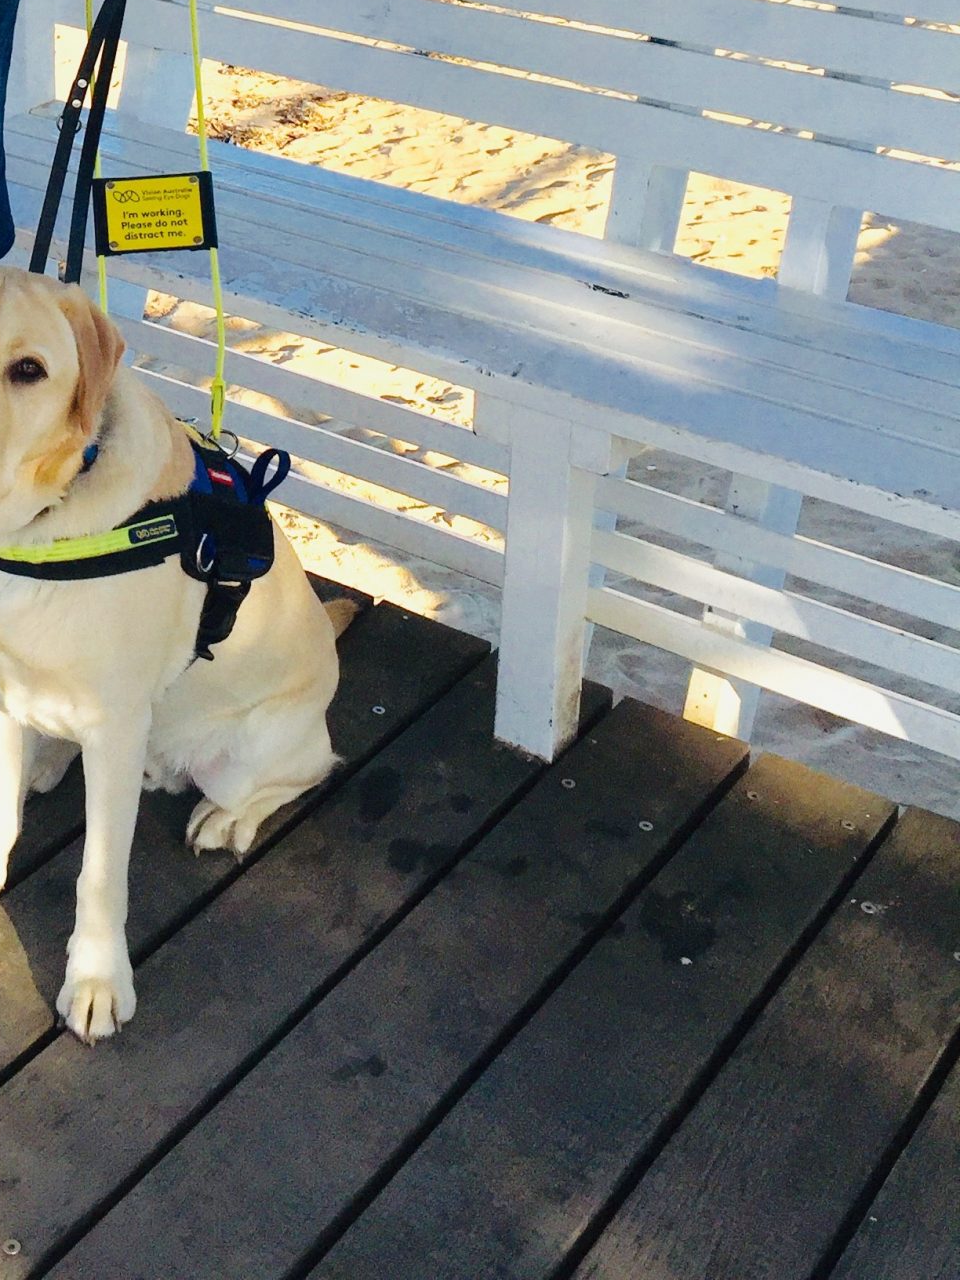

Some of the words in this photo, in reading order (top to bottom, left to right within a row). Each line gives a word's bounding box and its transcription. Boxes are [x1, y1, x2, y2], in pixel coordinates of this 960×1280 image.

[123, 211, 138, 219] I'm
[141, 209, 184, 218] working.
[121, 221, 152, 229] Please
[171, 218, 188, 226] not
[124, 231, 164, 240] distract
[167, 229, 186, 237] me.
